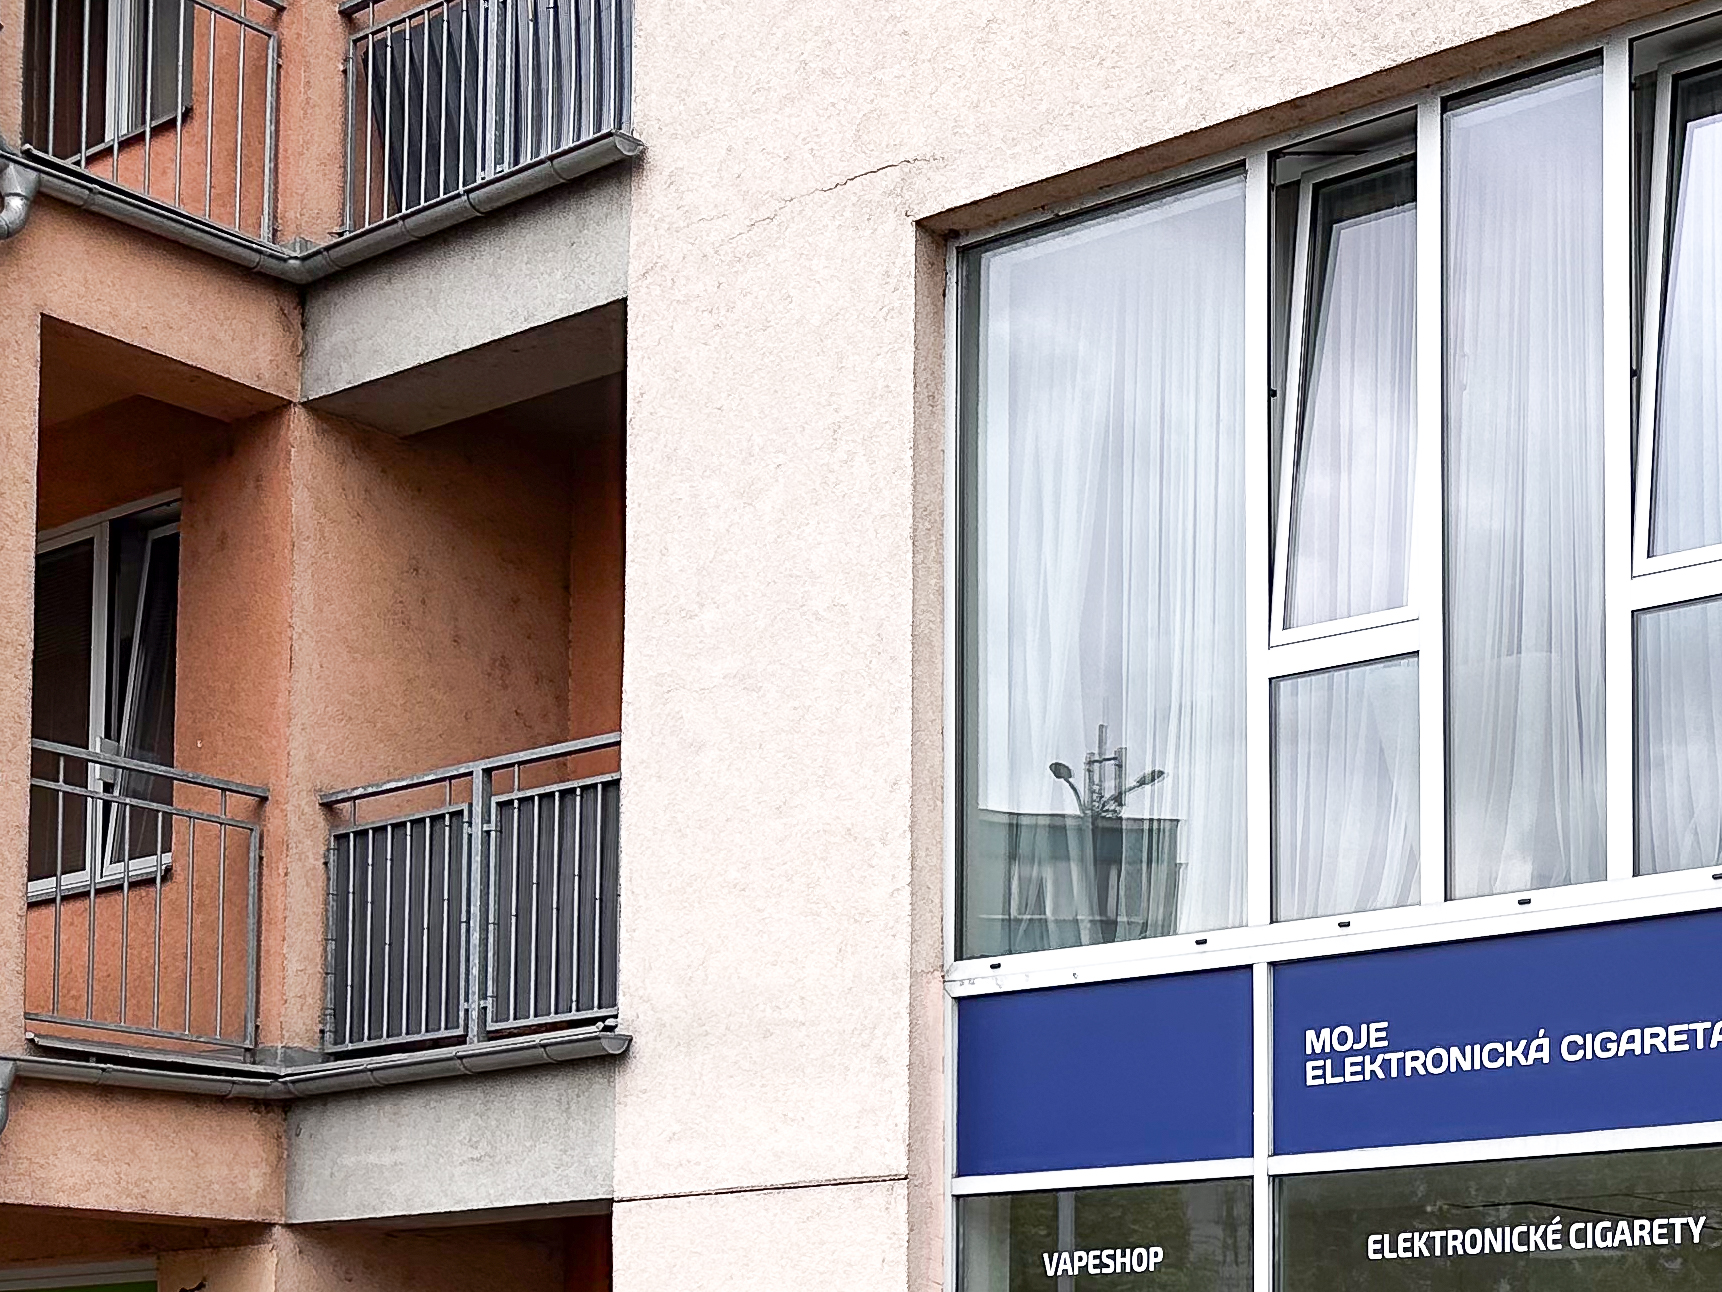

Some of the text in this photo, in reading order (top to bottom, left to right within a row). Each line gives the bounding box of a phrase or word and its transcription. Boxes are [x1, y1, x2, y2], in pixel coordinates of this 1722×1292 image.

[1304, 1021, 1389, 1055] MOJE
[1305, 1028, 1550, 1087] ELEKTRONICKÁ
[1366, 1215, 1706, 1260] ELEKTRONICKÉ CIGARETY
[1042, 1246, 1164, 1277] VAPESHOP
